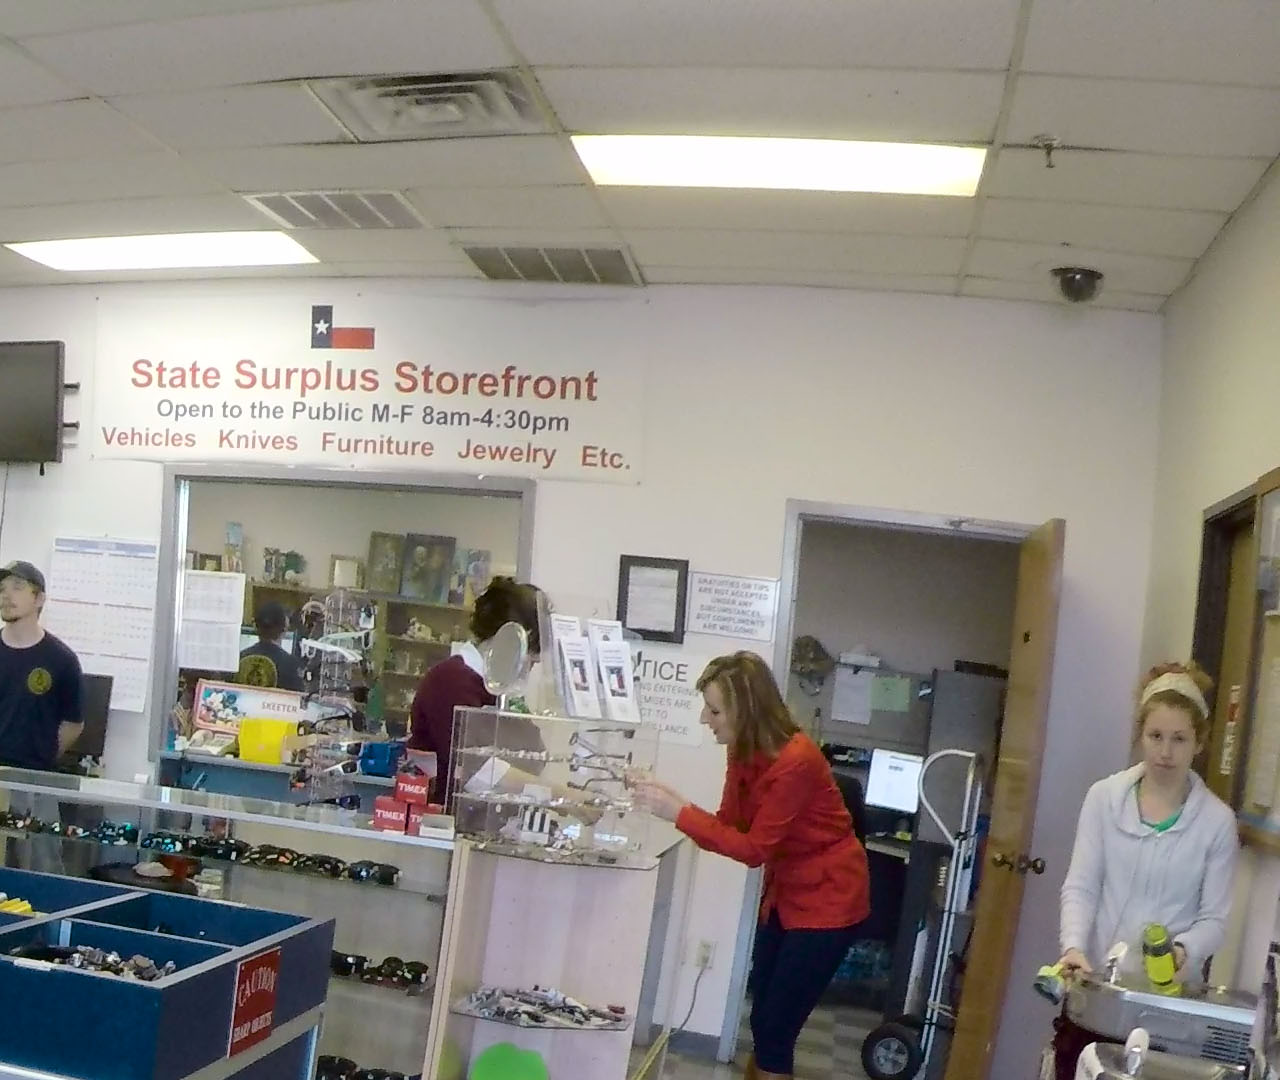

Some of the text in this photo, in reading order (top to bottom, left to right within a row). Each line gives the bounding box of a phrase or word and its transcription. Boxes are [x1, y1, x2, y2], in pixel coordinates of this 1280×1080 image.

[131, 359, 599, 401] State Surplus Storefront
[157, 399, 570, 435] Open to the Public M-F 8am-4:30pm
[101, 427, 631, 470] Vehicles Knives Furniture Jewelry Etc.
[633, 656, 689, 682] TICE
[261, 701, 299, 713] SKEETER
[399, 782, 427, 795] TIMEX
[375, 809, 407, 822] TIMEX
[238, 966, 277, 1007] CAUTION
